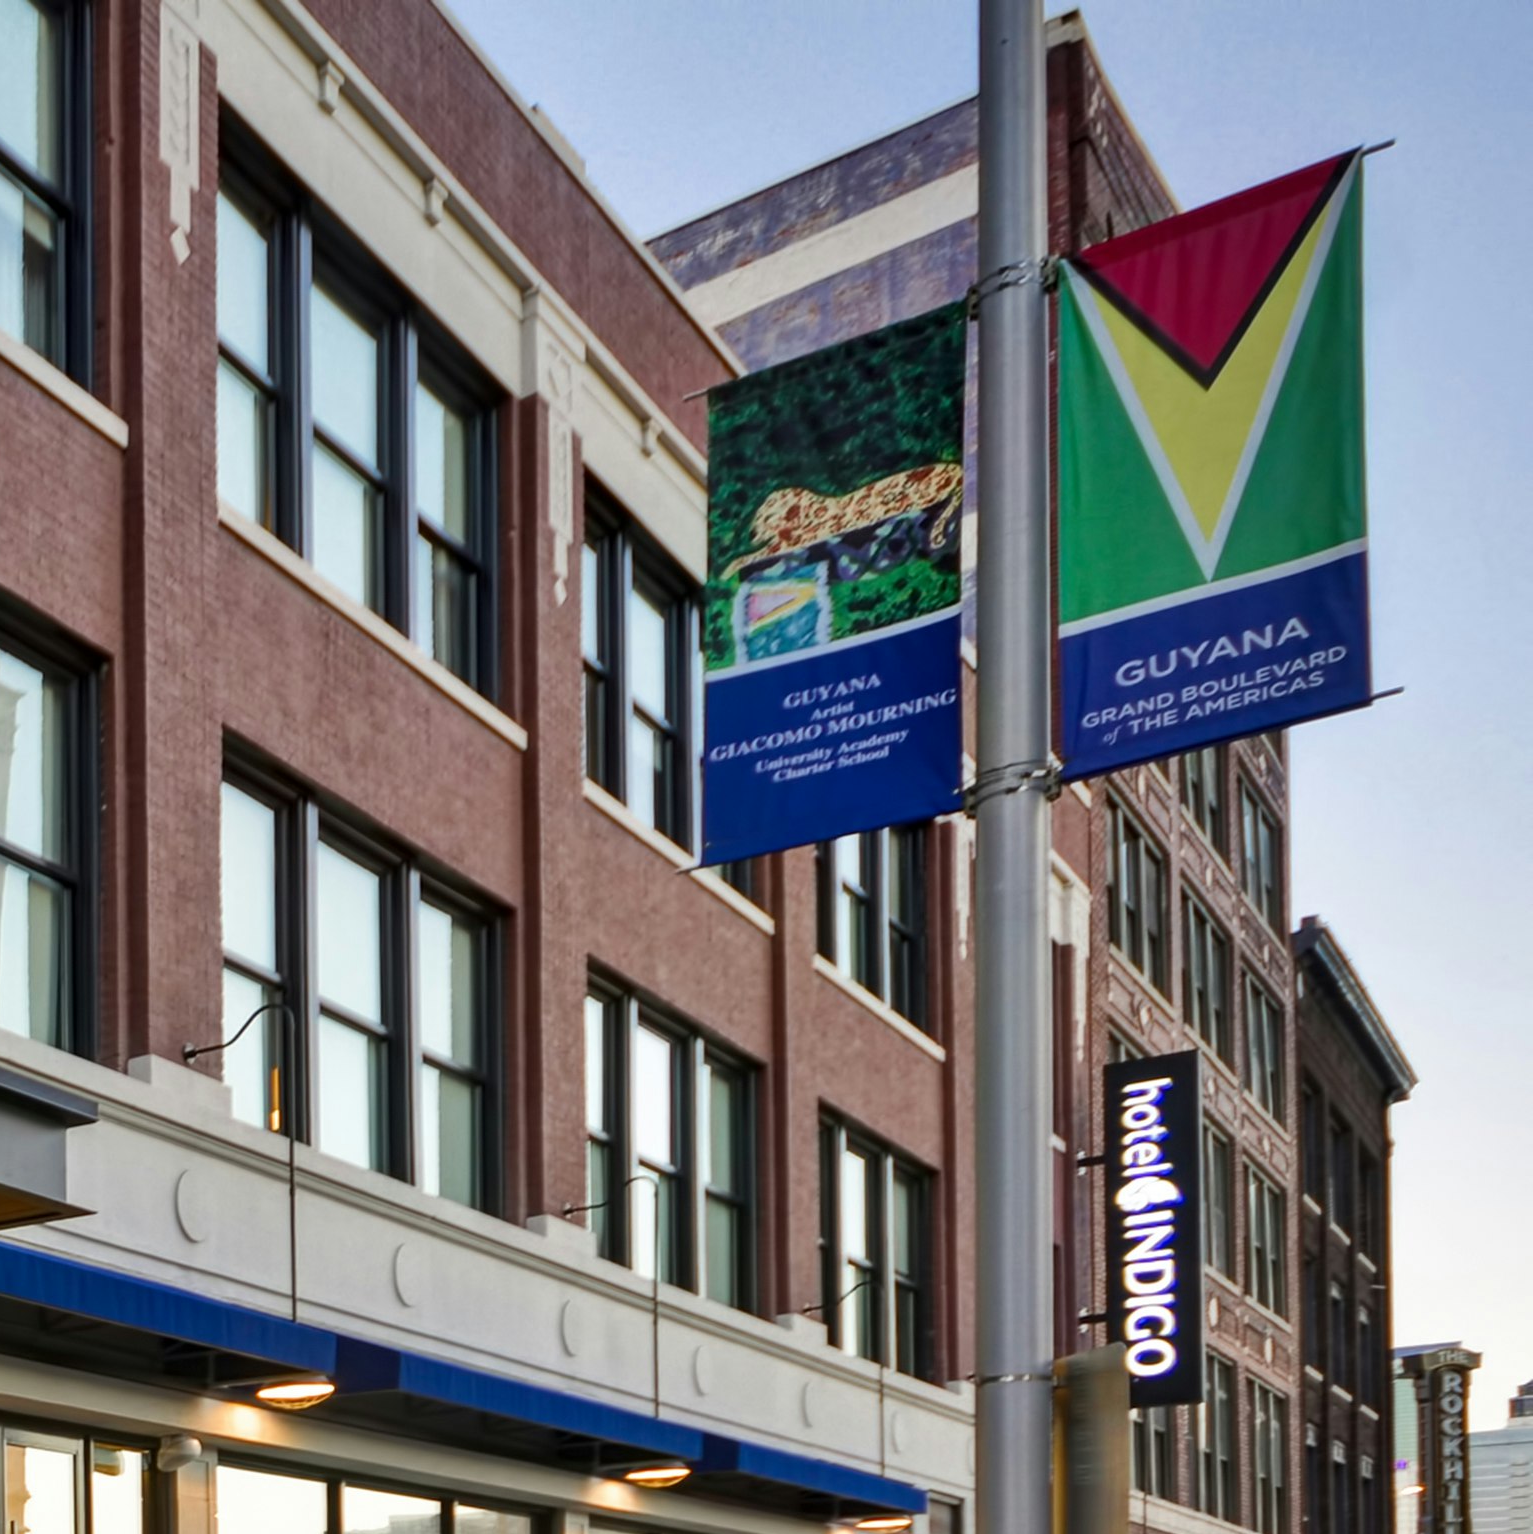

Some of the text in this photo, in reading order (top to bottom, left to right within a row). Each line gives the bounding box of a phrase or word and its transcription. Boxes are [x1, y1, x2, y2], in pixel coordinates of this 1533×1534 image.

[1114, 616, 1311, 687] GUYANA
[783, 673, 882, 710] GUYANA
[809, 700, 855, 722] Artist
[1081, 645, 1348, 729] GRAND BOULEVARD
[1102, 670, 1326, 745] of THE AMERICAS
[708, 687, 958, 763] GIACOMO MOURNING
[754, 728, 910, 774] University Academy
[772, 745, 890, 783] Charter School
[1121, 1076, 1177, 1378] hotel INDIGO
[1437, 1350, 1469, 1363] THE
